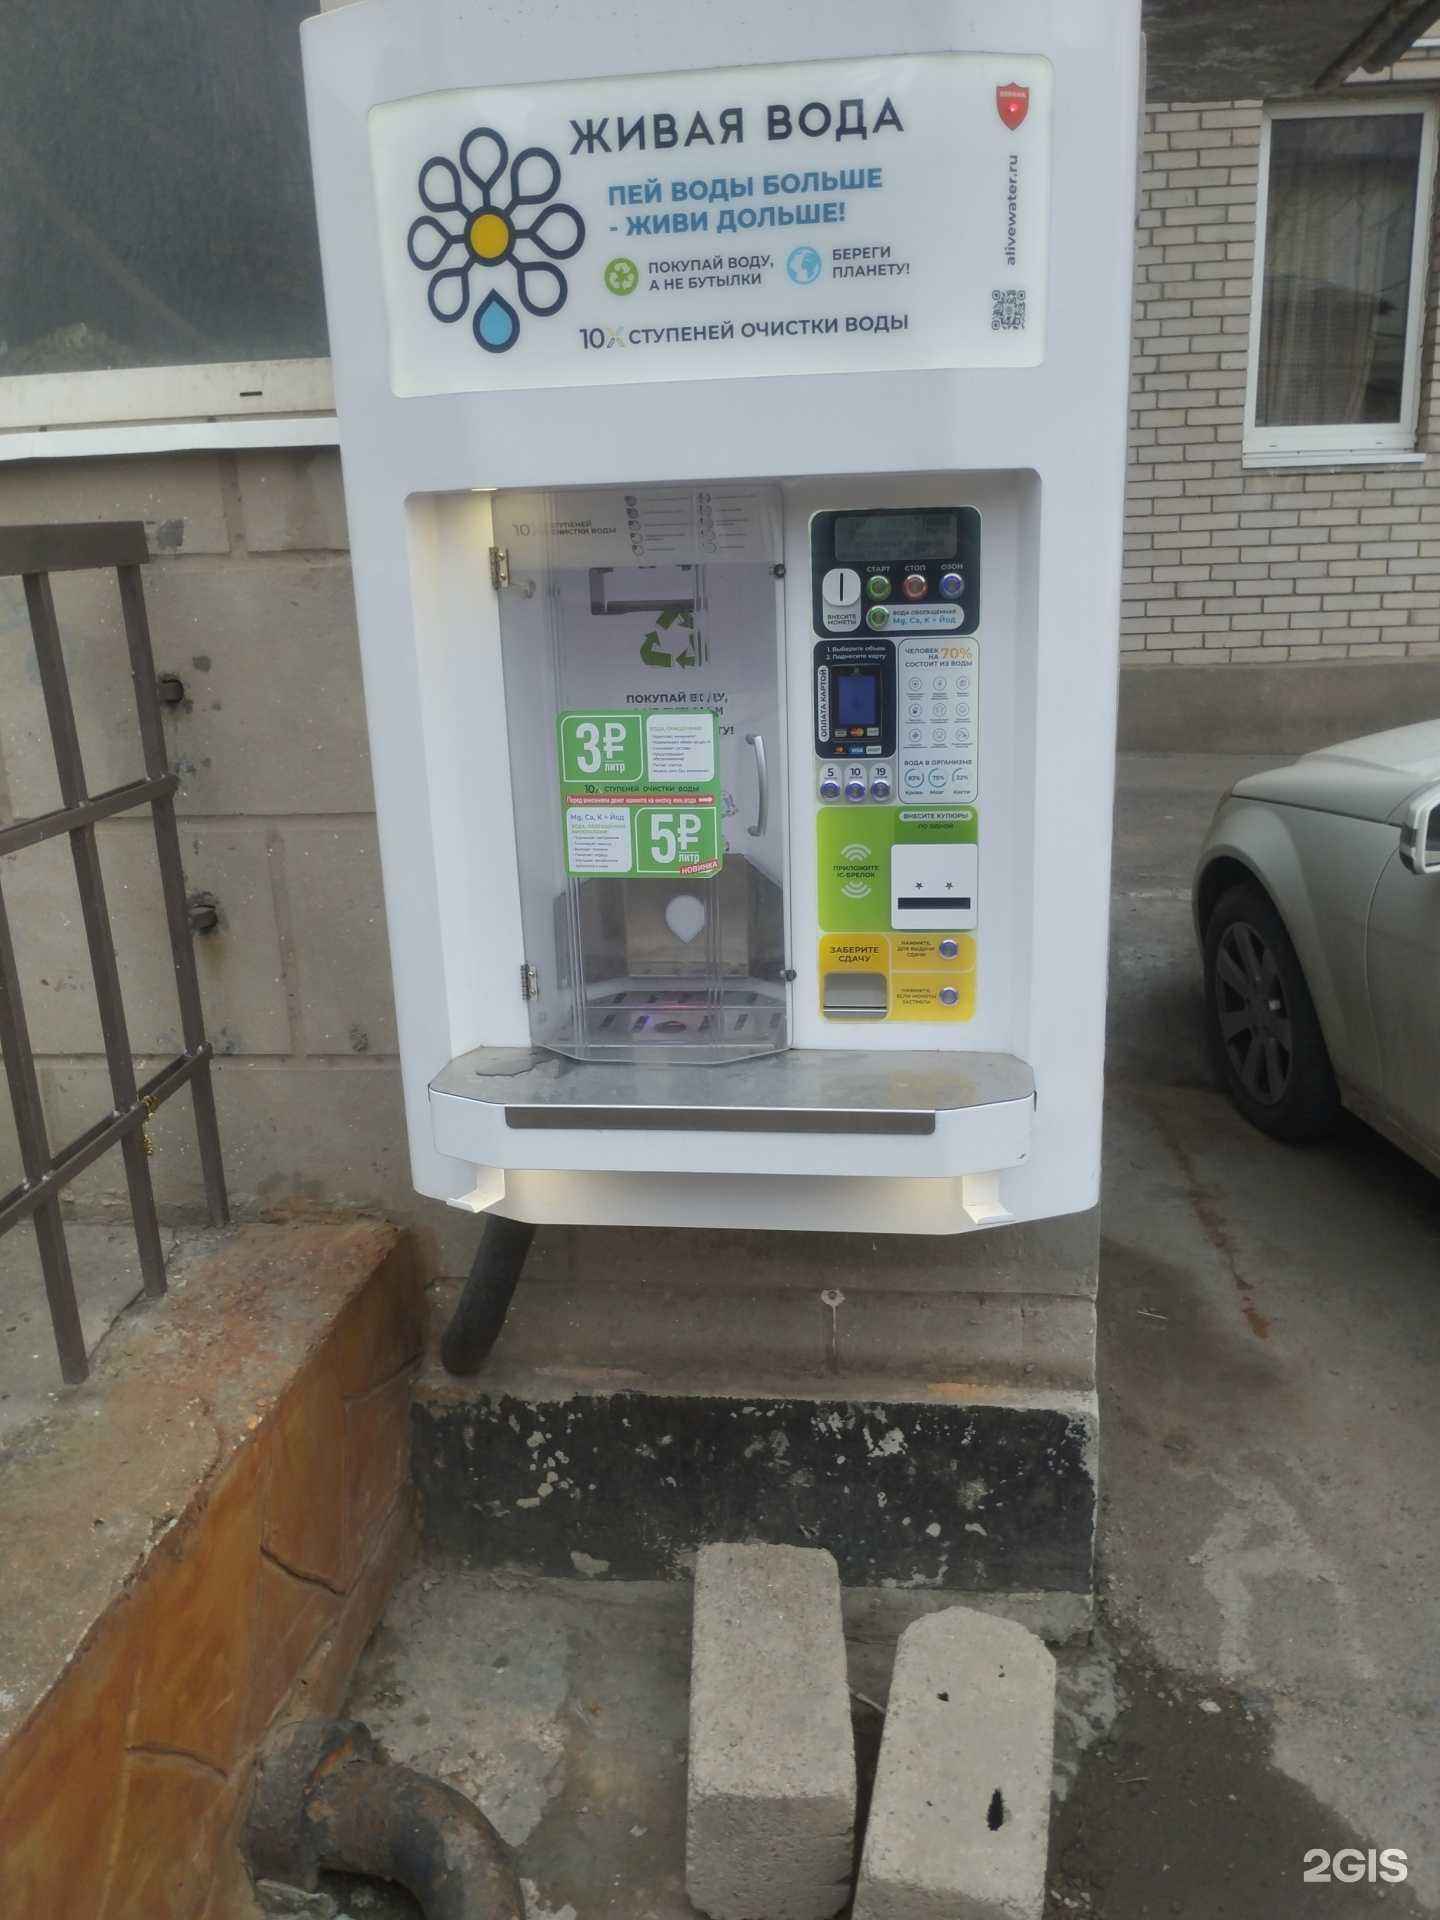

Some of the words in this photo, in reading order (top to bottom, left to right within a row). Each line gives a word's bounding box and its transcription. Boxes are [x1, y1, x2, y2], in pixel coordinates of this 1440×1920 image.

[569, 107, 744, 155] ЖИВАЯ
[767, 96, 904, 142] ВОДА
[608, 177, 663, 206] ПЕЙ
[671, 176, 754, 203] ВОДЫ
[763, 167, 883, 195] БОЛЬШЕ
[1004, 154, 1018, 266] alivewater.ru
[626, 211, 709, 236] ЖИВИ
[716, 202, 846, 234] ДОЛЬШЕ!
[832, 246, 892, 261] БЕРЕГИ
[648, 254, 723, 274] ПОКУПАЙ
[728, 254, 775, 271] ВОДУ,
[832, 263, 910, 279] ПЛАНЕТУ!
[649, 279, 660, 292] А
[664, 277, 684, 291] НЕ
[688, 273, 762, 290] БУТЫЛКИ
[628, 320, 735, 345] СТУПЕНЕЙ
[740, 317, 839, 339] ОЧИСТКИ
[845, 314, 910, 334] ВОДЫ
[866, 565, 891, 573] СТАРТ
[819, 669, 828, 702] КАРТОЙ
[625, 691, 689, 705] ПОКУПАЙ
[819, 703, 828, 738] ОПЛАТА
[827, 767, 834, 777] 5
[850, 767, 861, 776] 10
[876, 767, 886, 776] 19
[903, 812, 935, 820] ВНЕСИТЕ
[680, 857, 720, 876] НОВИНКА
[830, 946, 880, 954] ЗАБЕРИТЕ
[838, 955, 871, 963] СДАЧУ
